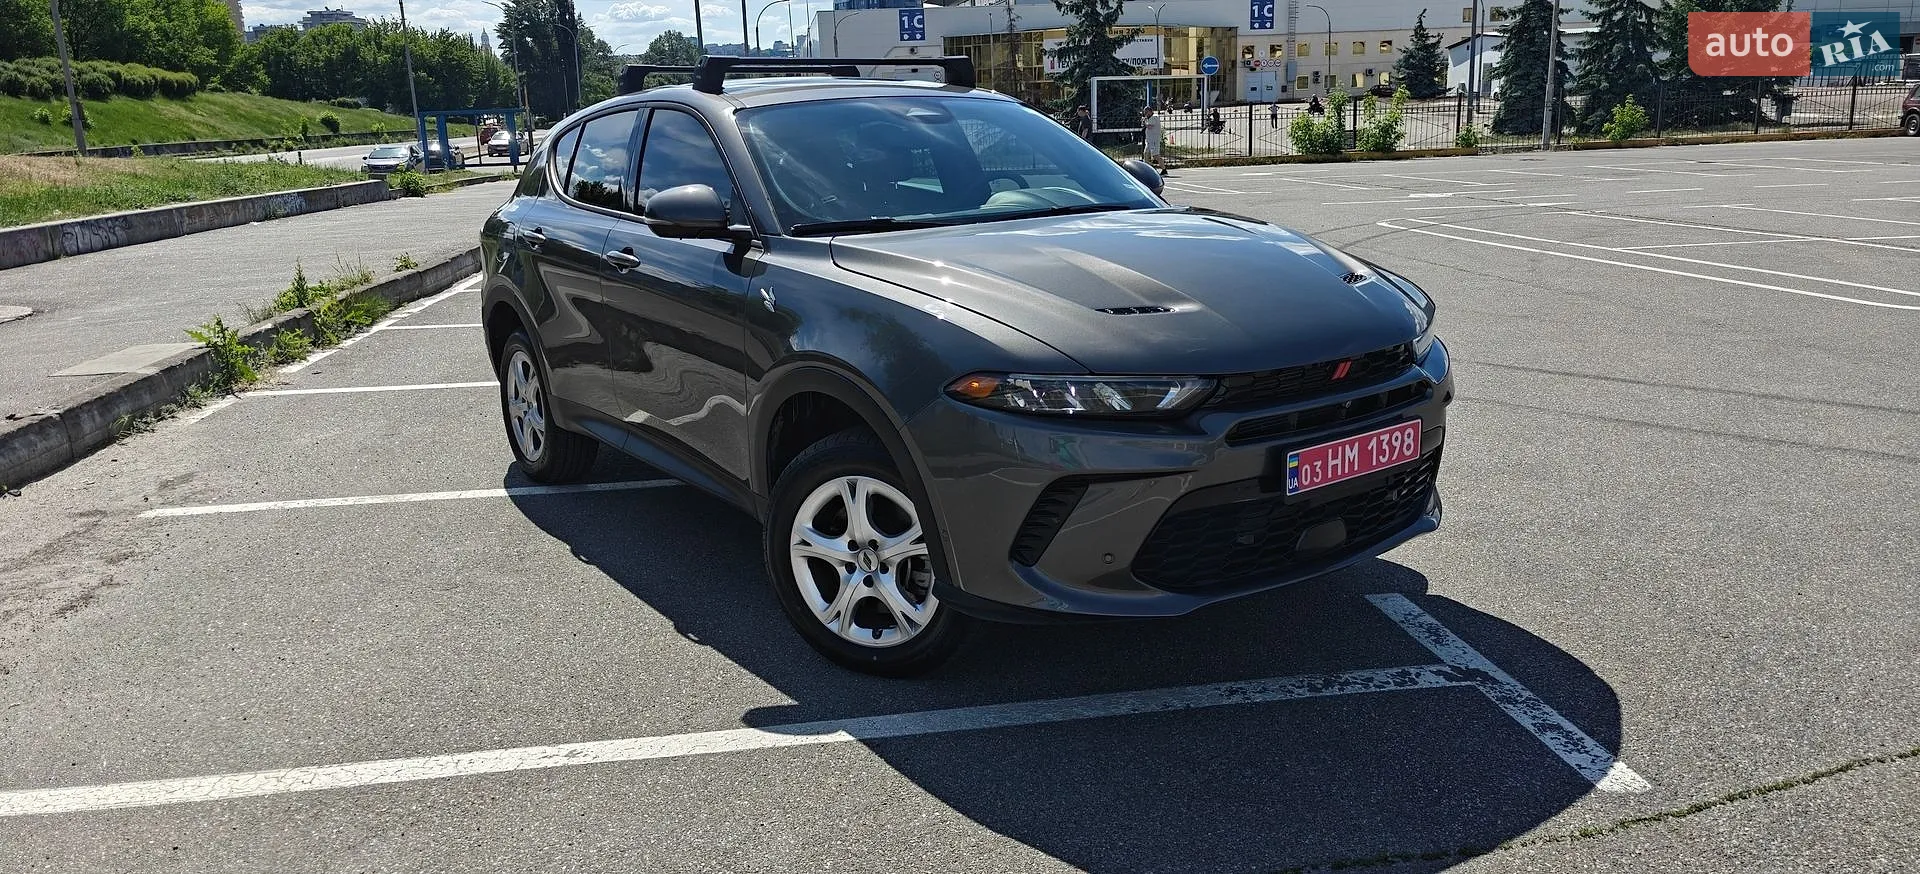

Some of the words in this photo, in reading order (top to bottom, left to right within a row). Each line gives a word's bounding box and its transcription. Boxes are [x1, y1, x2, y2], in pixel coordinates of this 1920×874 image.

[1301, 460, 1322, 486] 03
[1327, 441, 1359, 478] HM
[1367, 427, 1414, 466] 1398
[1288, 477, 1299, 490] UA
